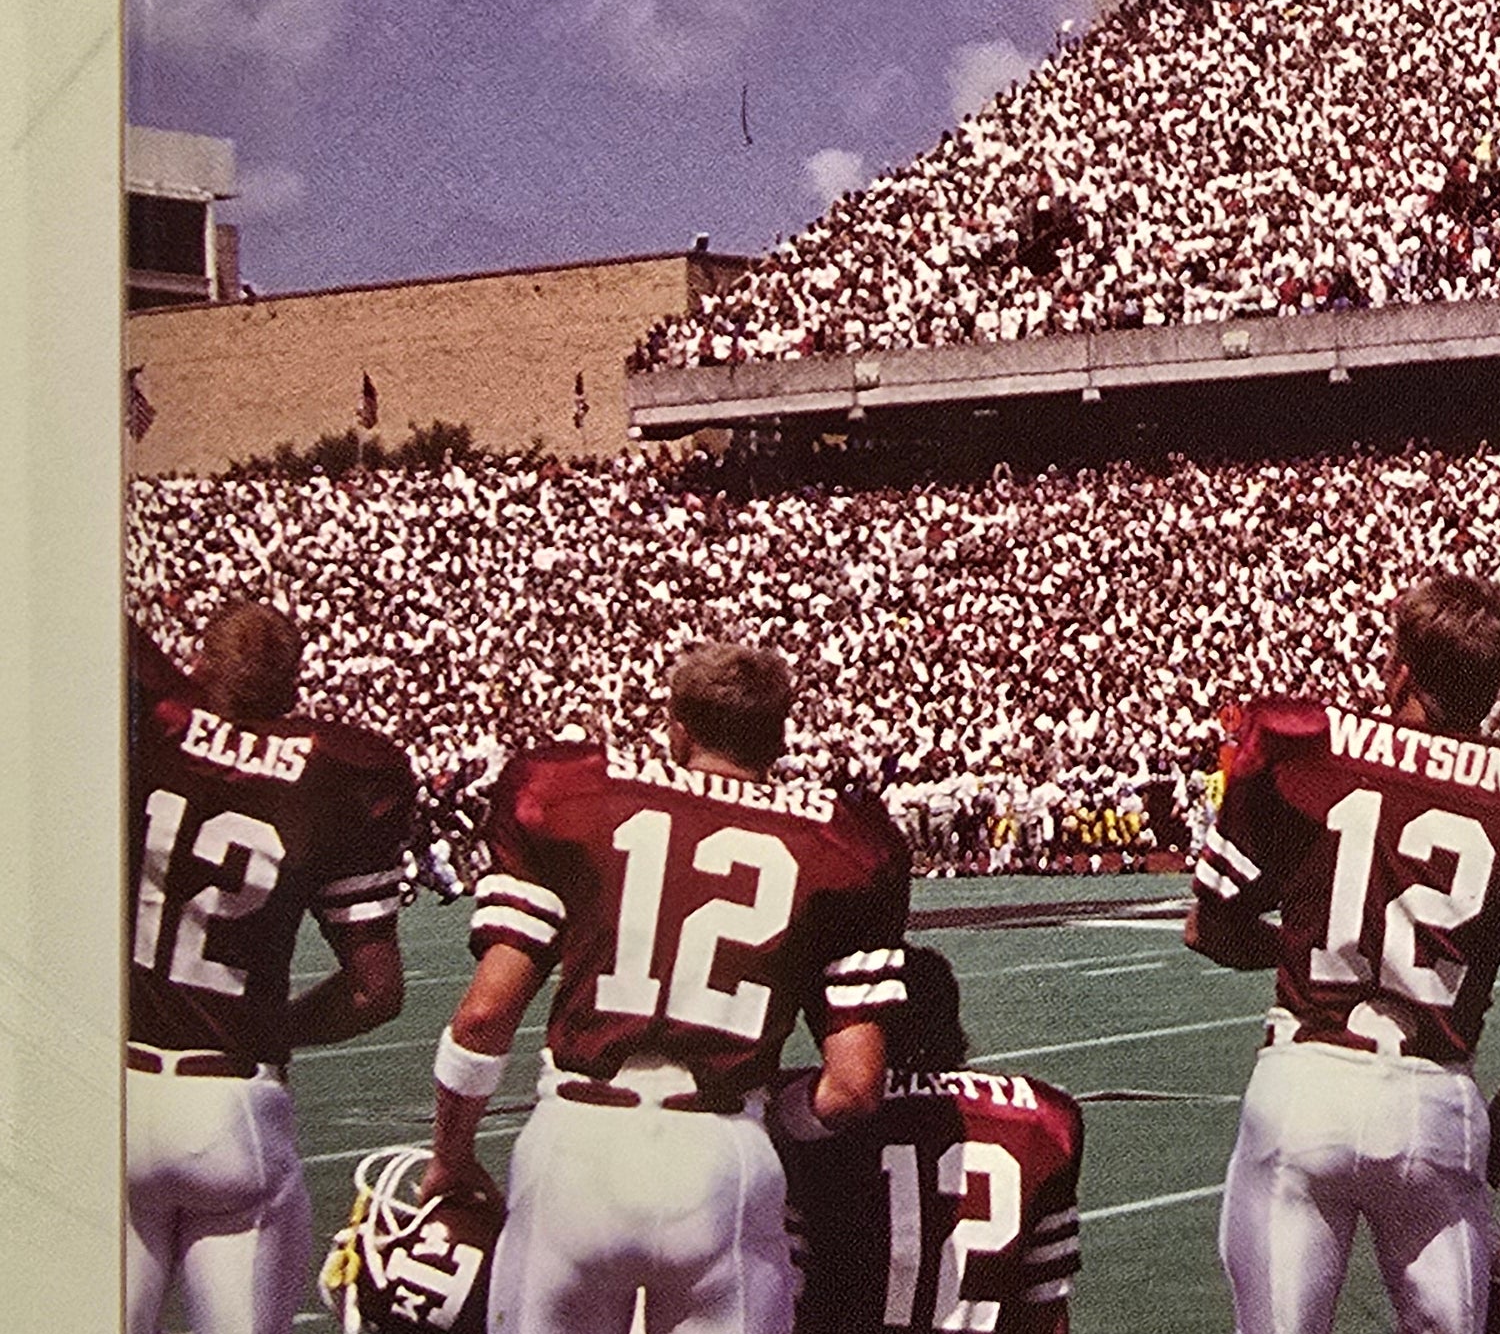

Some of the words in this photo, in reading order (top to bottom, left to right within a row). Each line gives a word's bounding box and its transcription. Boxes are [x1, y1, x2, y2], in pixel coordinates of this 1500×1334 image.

[181, 708, 312, 783] ELLIS
[604, 745, 838, 823] SANDERS
[132, 788, 287, 997] 12
[594, 808, 799, 1041] 12
[1310, 788, 1496, 1008] 12
[880, 1140, 1023, 1333] 12
